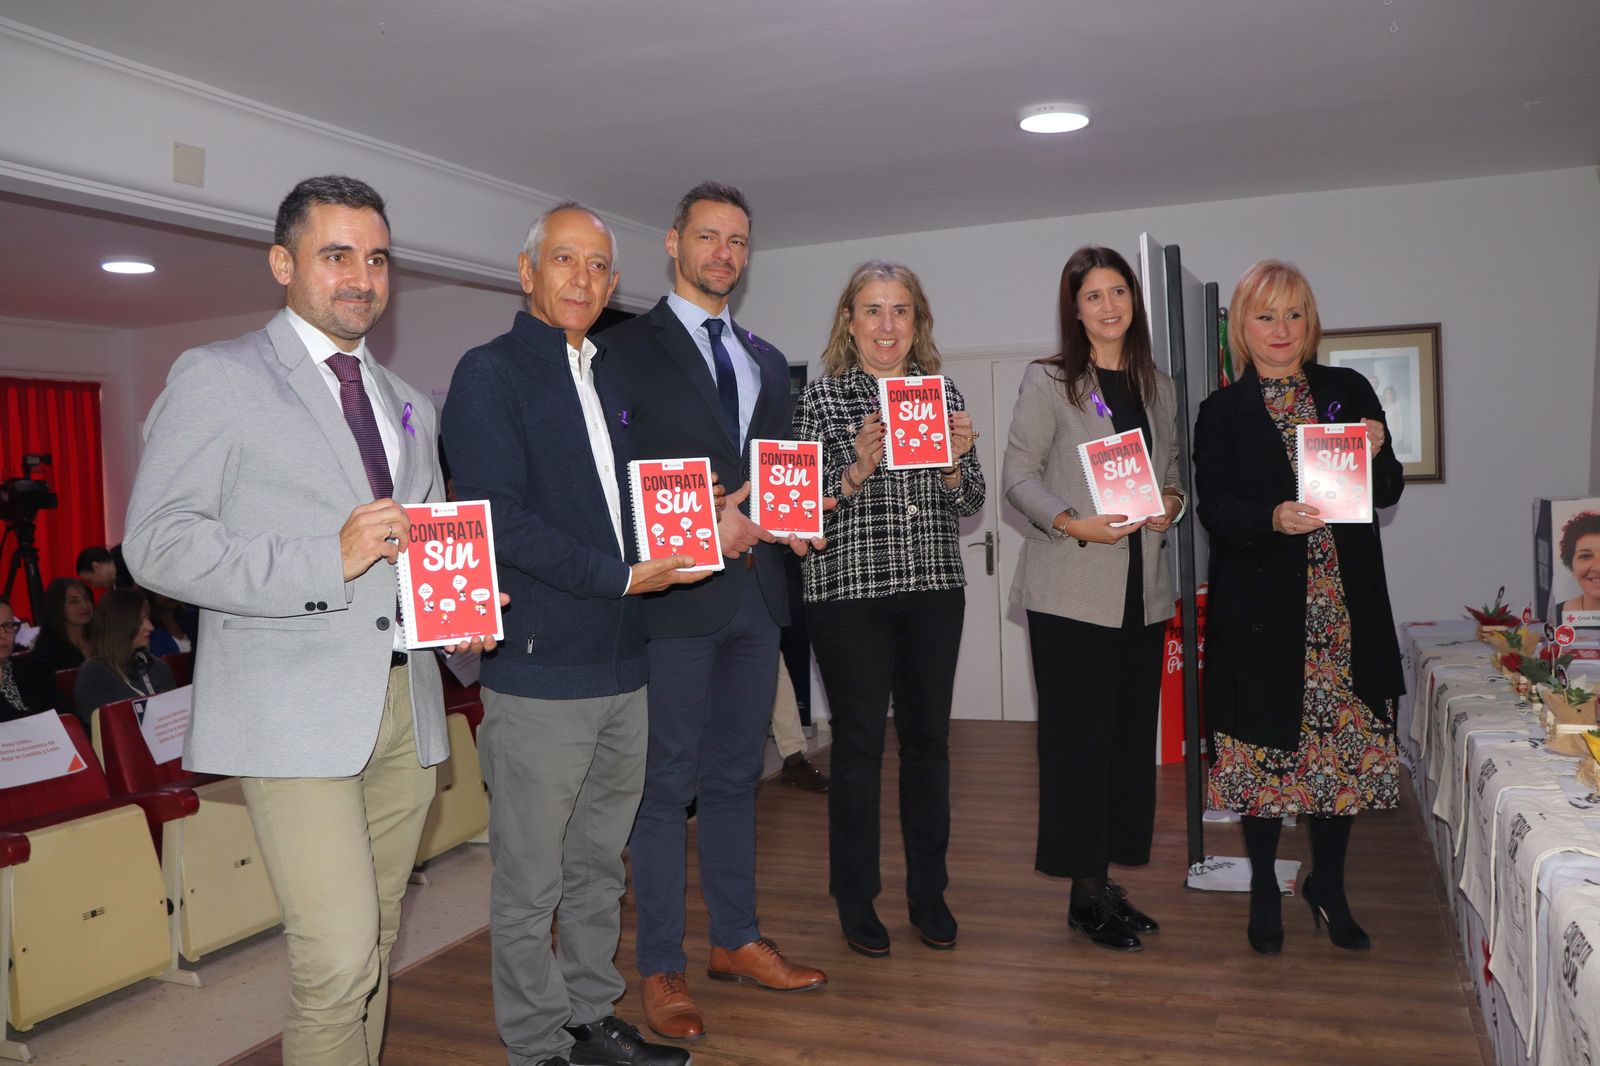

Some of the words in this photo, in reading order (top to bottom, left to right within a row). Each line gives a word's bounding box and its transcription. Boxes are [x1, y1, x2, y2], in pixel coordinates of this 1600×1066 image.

[889, 388, 940, 403] CONTRATA
[899, 398, 938, 421] Sin
[1090, 442, 1143, 466] CONTRATA
[1306, 437, 1364, 451] CONTRATA
[760, 452, 816, 467] CONTRATA
[1103, 456, 1142, 481] Sin
[1315, 448, 1359, 471] Sin
[643, 473, 706, 492] CONTRATA
[768, 463, 811, 487] Sin
[655, 486, 703, 514] Sin
[409, 519, 485, 543] CONTRATA
[423, 536, 480, 572] Sin
